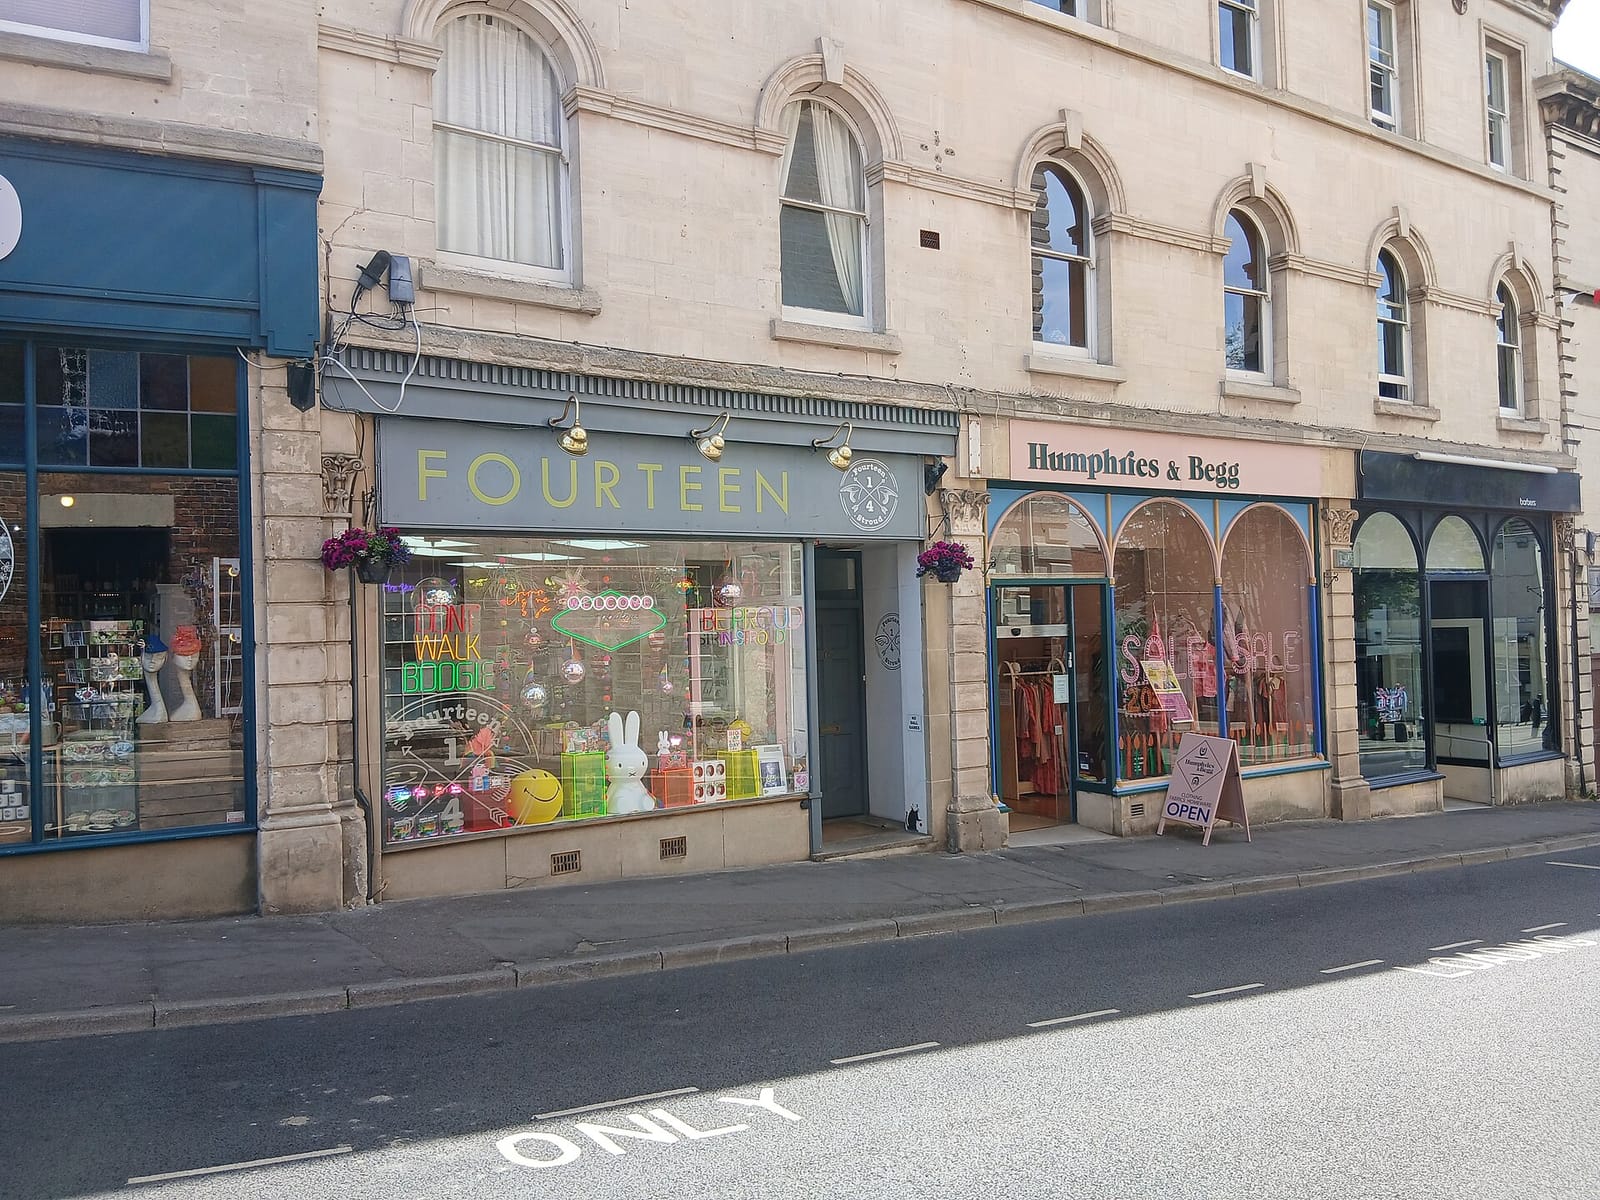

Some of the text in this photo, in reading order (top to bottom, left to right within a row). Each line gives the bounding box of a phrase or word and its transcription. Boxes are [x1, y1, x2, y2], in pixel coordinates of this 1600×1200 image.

[852, 464, 886, 478] Fourteen
[1027, 442, 1240, 489] Humphries & Begg
[416, 449, 789, 515] FOURTEEN
[866, 476, 873, 488] 1
[856, 514, 883, 526] Stroud
[865, 500, 874, 512] 4
[568, 596, 653, 610] WELCOME
[702, 606, 803, 631] BE PROUD
[415, 633, 481, 661] WALK
[1232, 630, 1300, 675] SALE
[403, 660, 496, 693] BOOGIE
[443, 738, 461, 767] 1
[441, 798, 465, 828] 4
[1167, 802, 1210, 823] OPEN
[496, 1087, 801, 1168] ONLY
